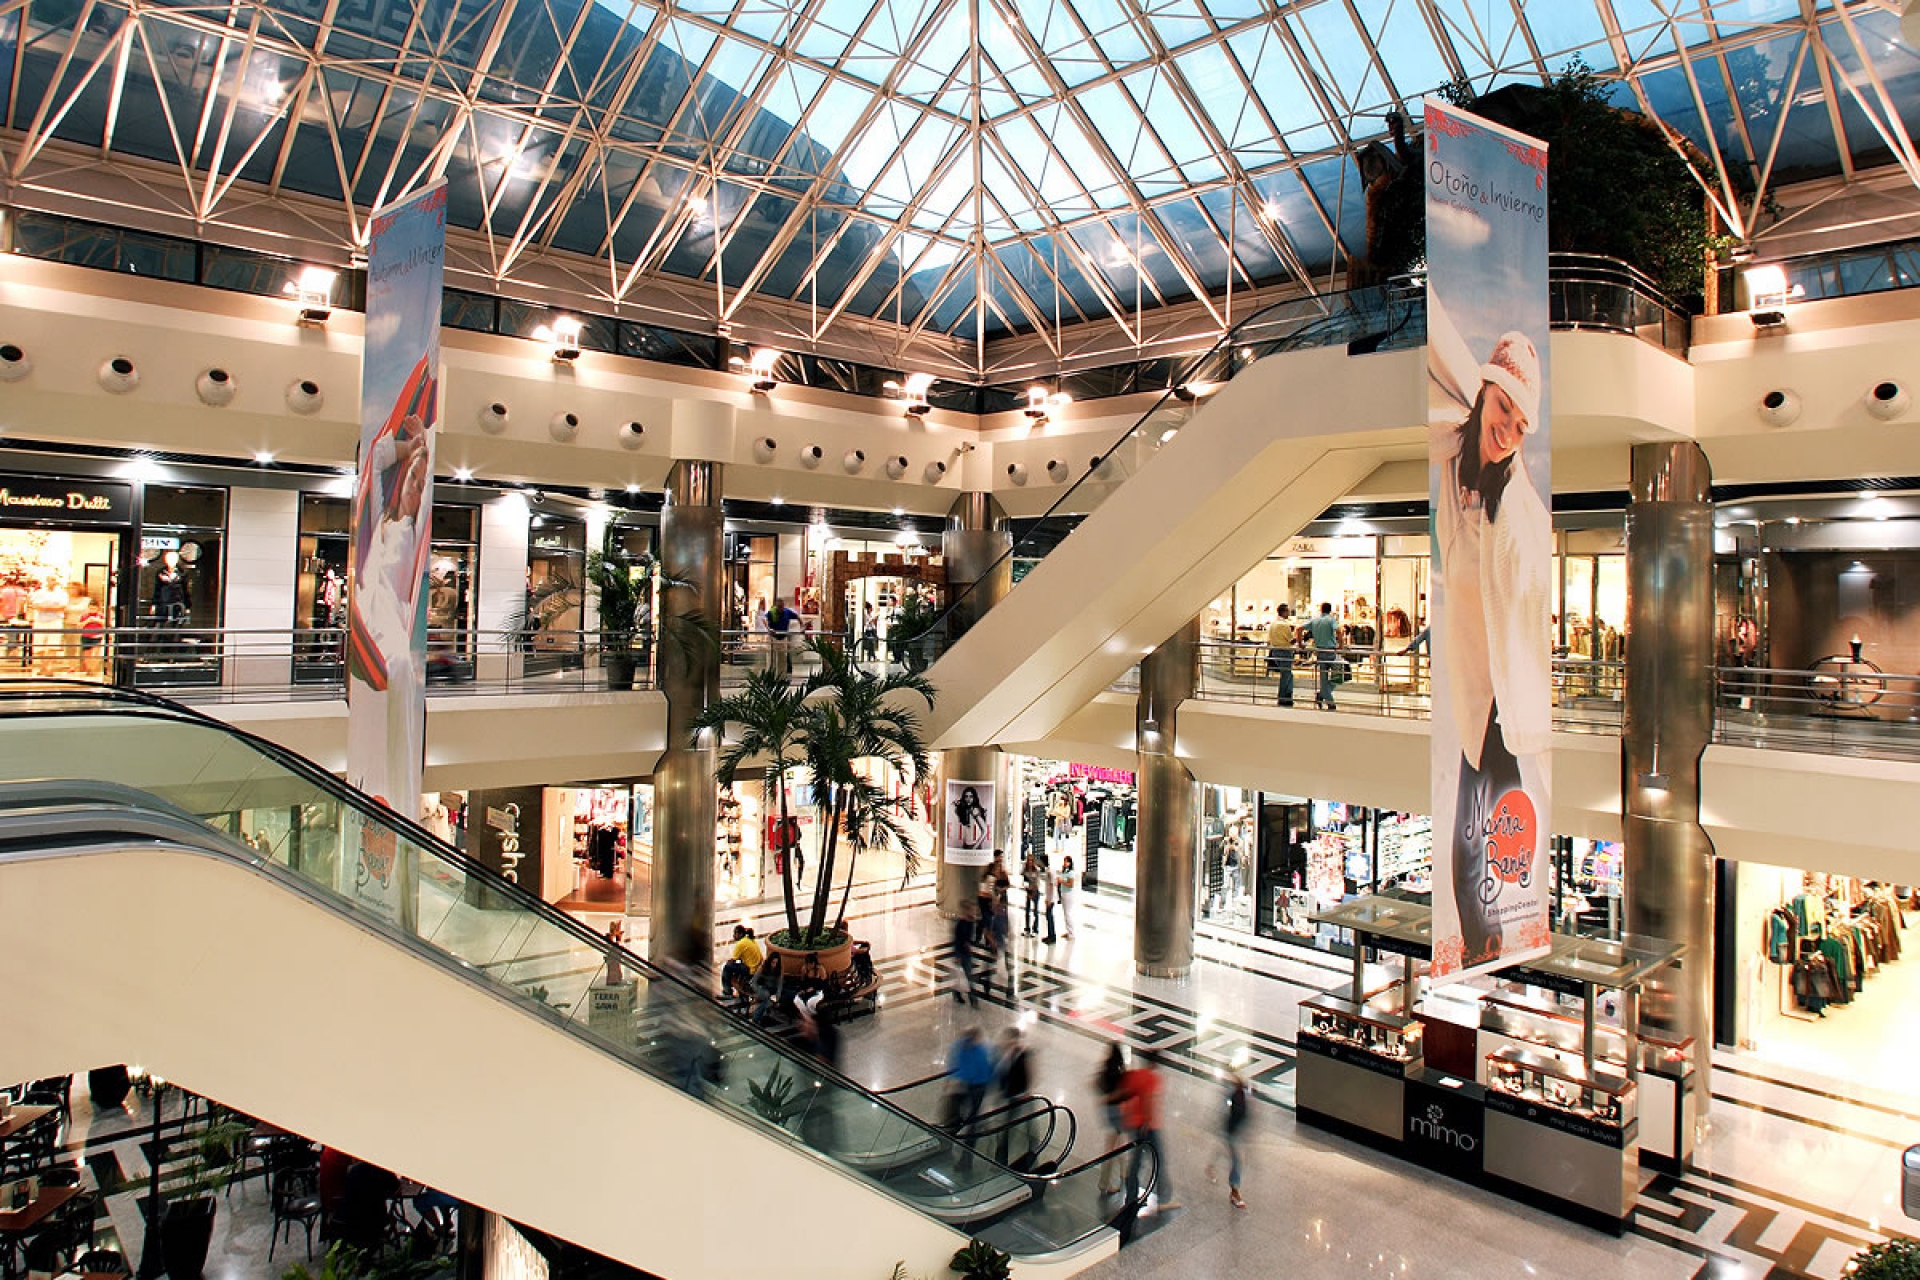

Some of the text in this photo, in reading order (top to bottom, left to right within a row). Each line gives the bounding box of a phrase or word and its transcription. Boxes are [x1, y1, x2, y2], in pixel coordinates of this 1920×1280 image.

[1430, 161, 1544, 222] Otoño & Invierno
[409, 245, 443, 269] Winter
[66, 492, 112, 510] Dutti
[1465, 779, 1525, 840] Marina
[1410, 1114, 1475, 1151] mimo
[1549, 1116, 1590, 1135] meican
